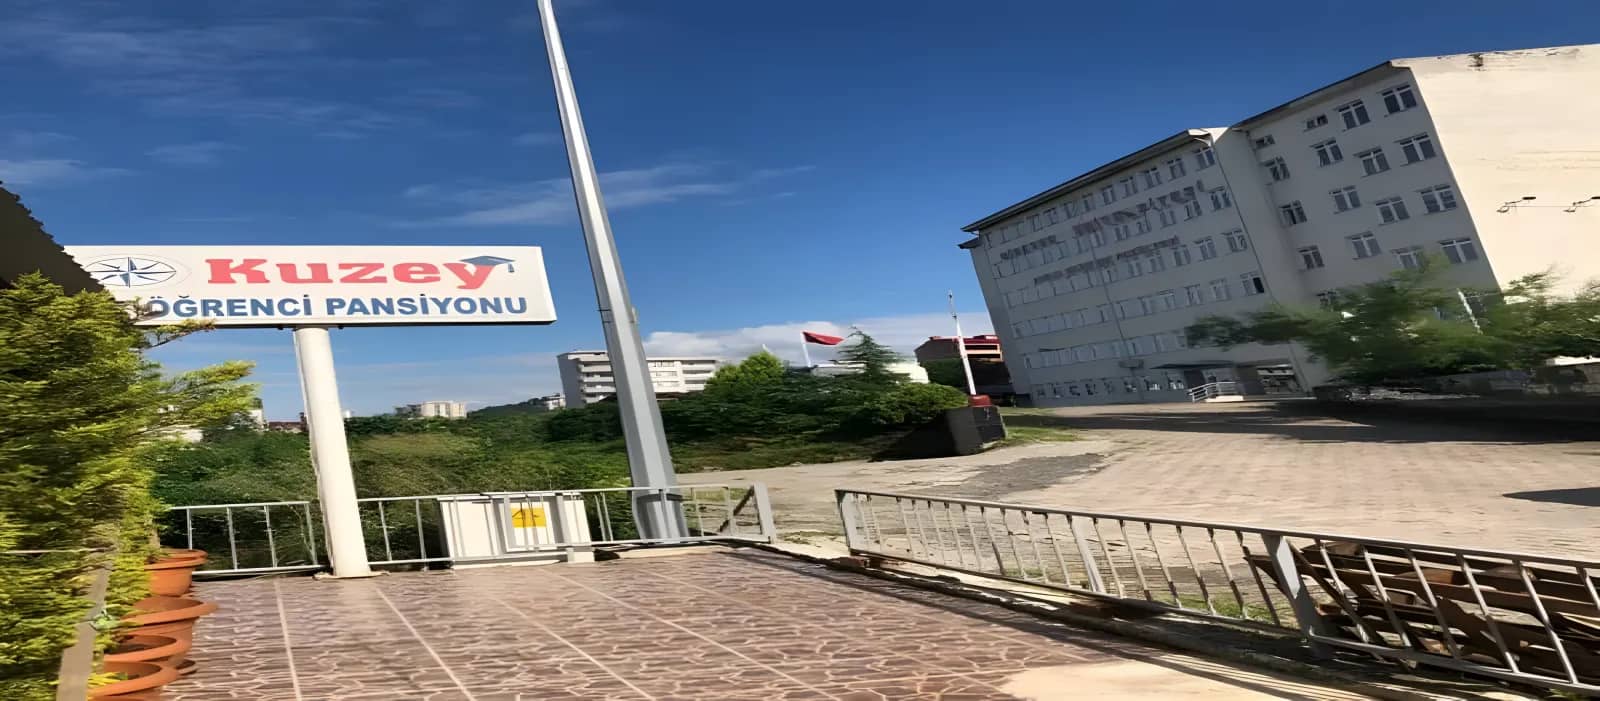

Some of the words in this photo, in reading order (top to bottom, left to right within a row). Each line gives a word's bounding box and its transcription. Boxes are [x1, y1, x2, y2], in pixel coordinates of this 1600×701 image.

[205, 258, 495, 290] Kuzey
[147, 295, 312, 318] ÖĞRENCİ
[326, 293, 528, 316] PANSİYONU
